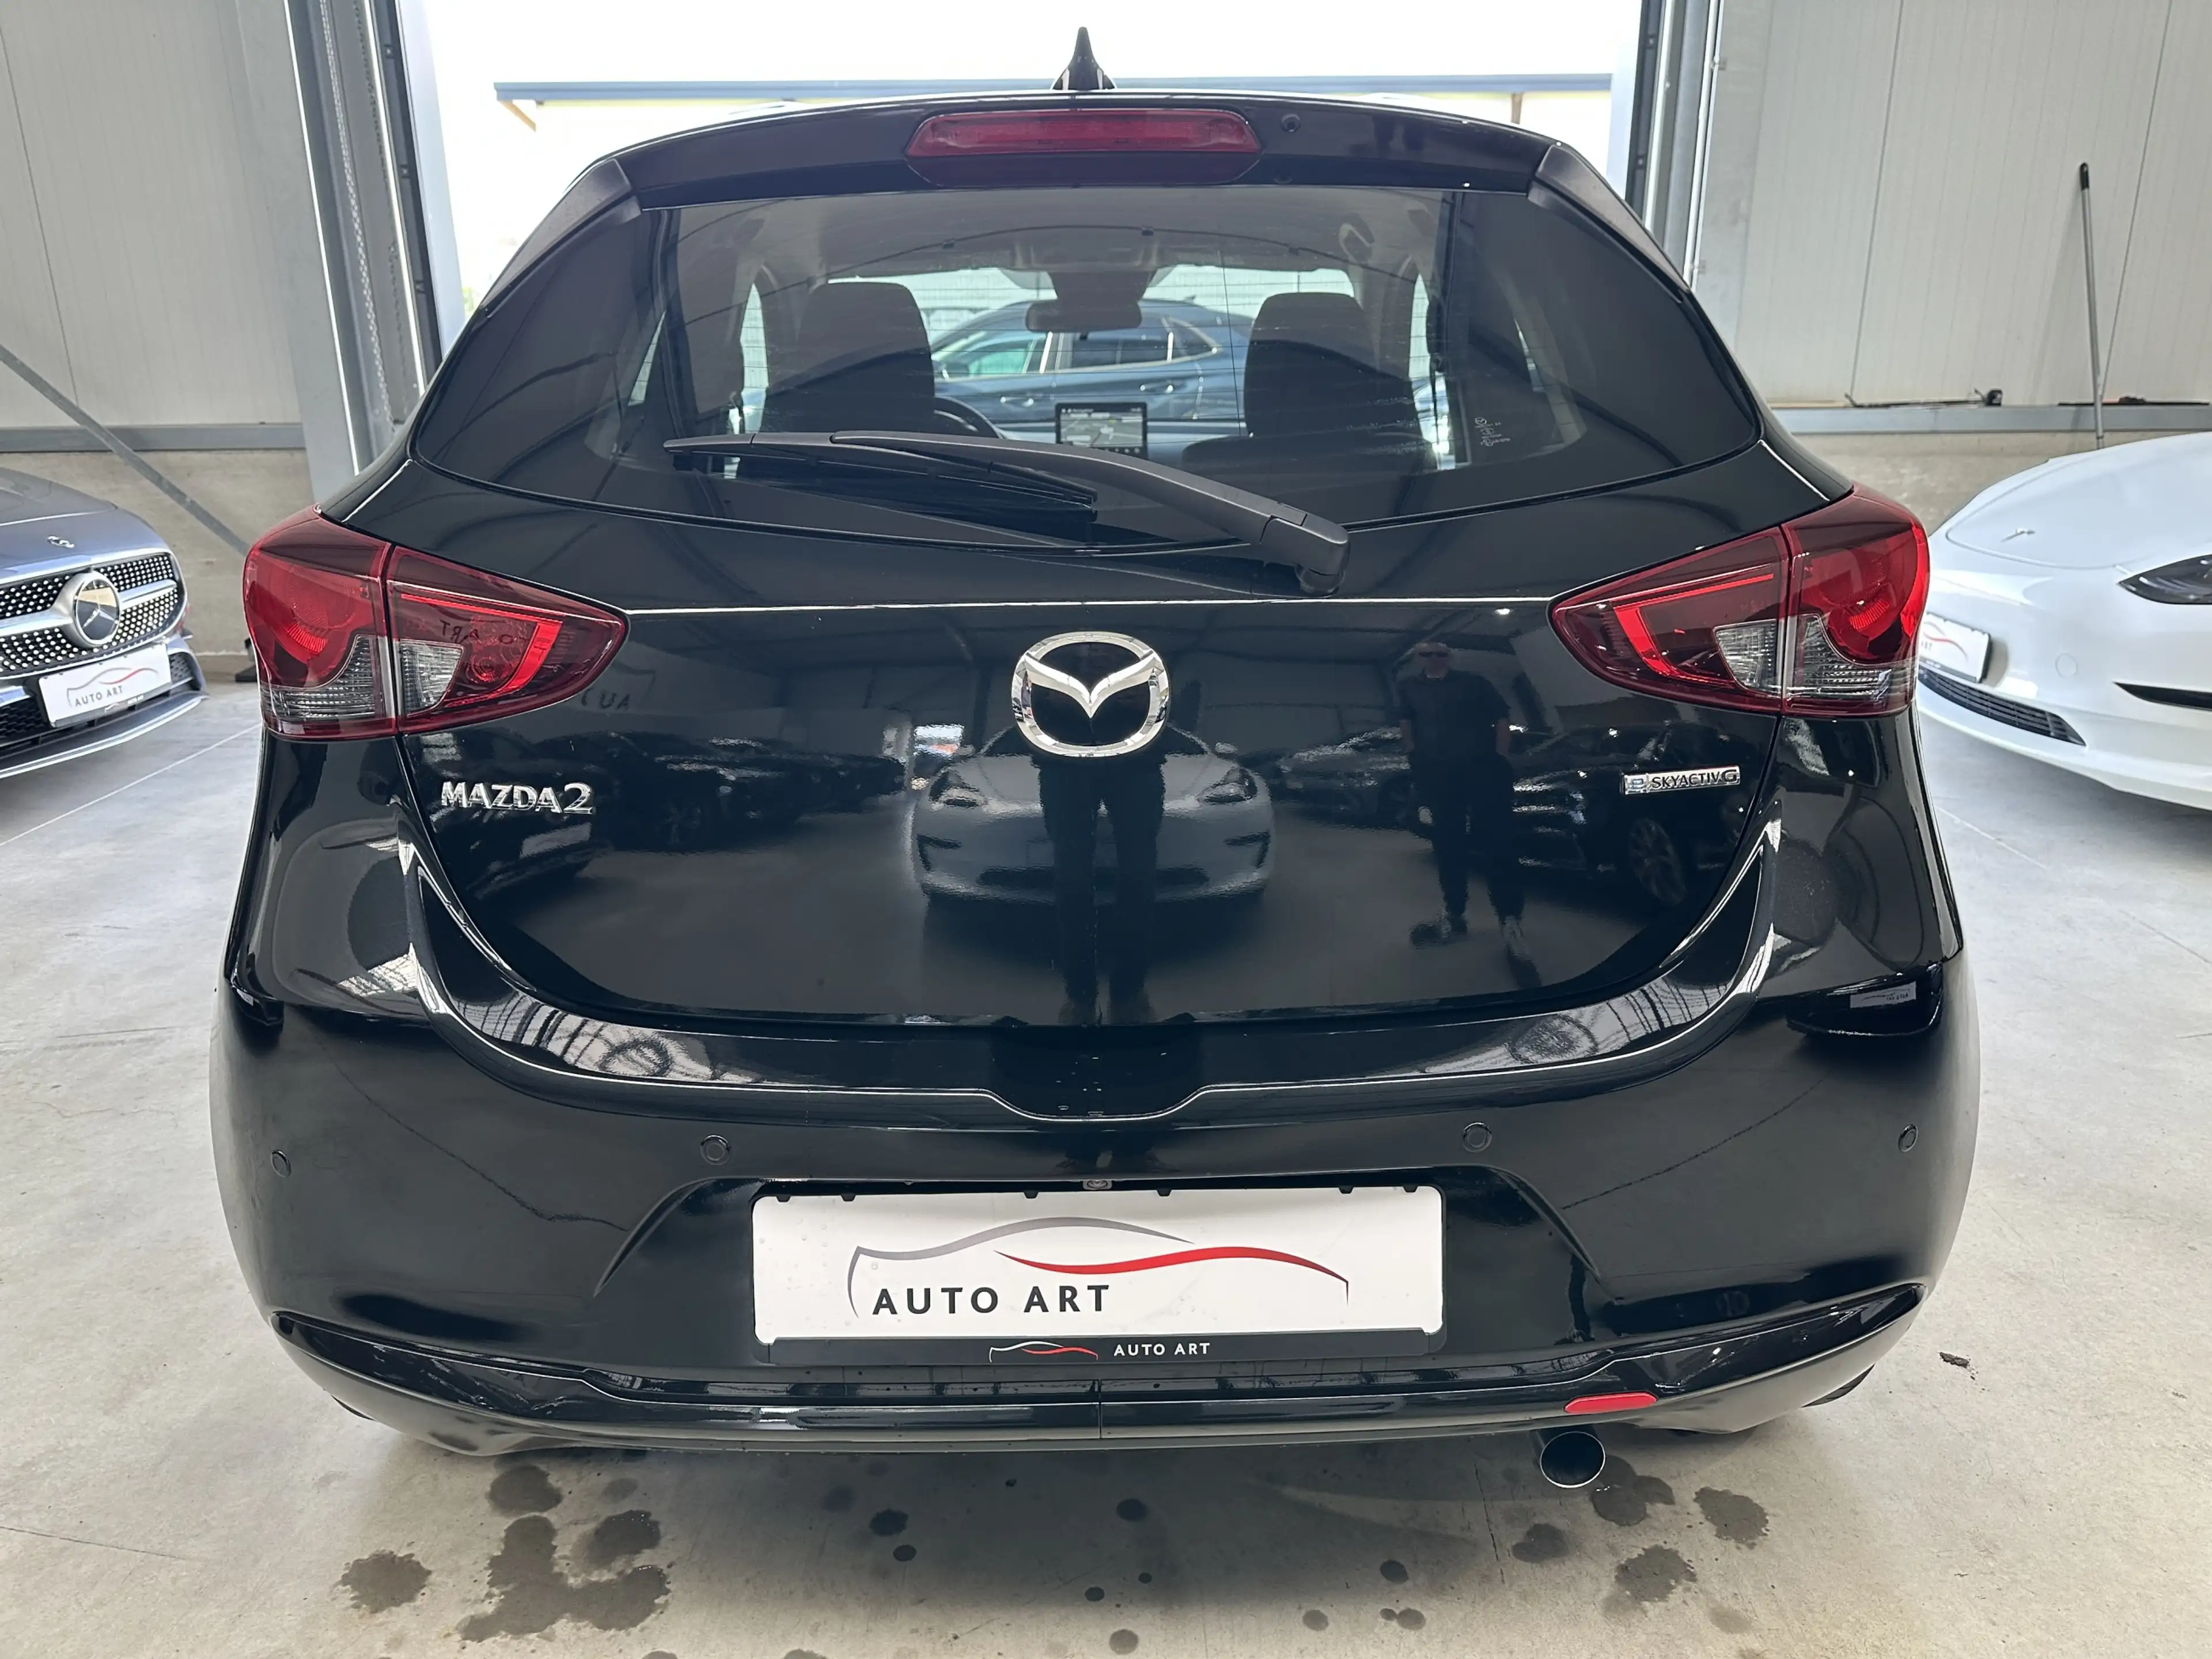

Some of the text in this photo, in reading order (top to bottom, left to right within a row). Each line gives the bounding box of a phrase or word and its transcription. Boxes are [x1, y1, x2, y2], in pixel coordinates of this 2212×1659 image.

[75, 685, 123, 707] AUTO ART
[441, 781, 593, 815] MAZDA2
[872, 1285, 1109, 1315] AUTO ART
[1113, 1342, 1210, 1356] AUTO ART
